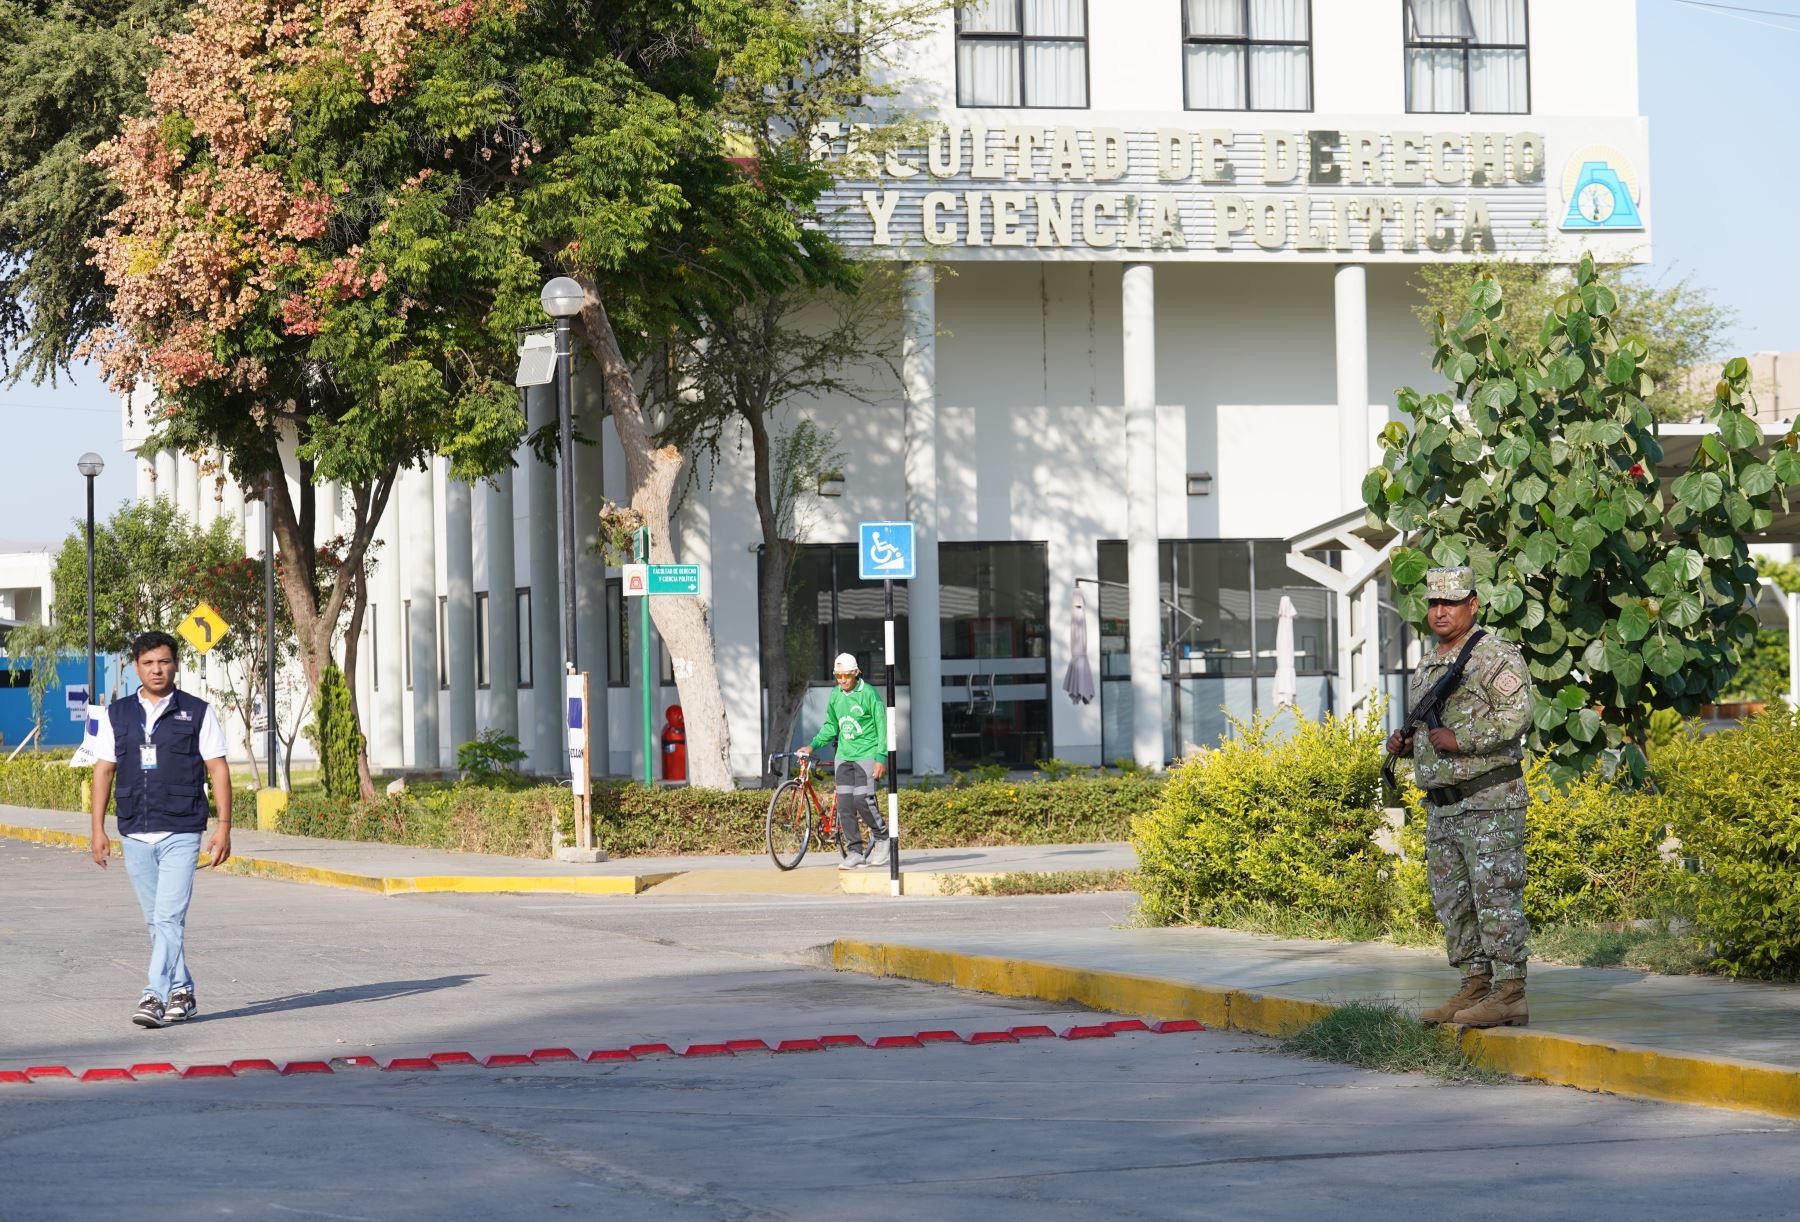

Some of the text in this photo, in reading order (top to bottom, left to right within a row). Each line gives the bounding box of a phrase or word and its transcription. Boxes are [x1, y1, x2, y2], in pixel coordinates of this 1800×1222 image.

[1156, 128, 1234, 182] DE
[1262, 129, 1545, 185] DERECHO
[862, 190, 1496, 254] Y CIENCIA POLITICA
